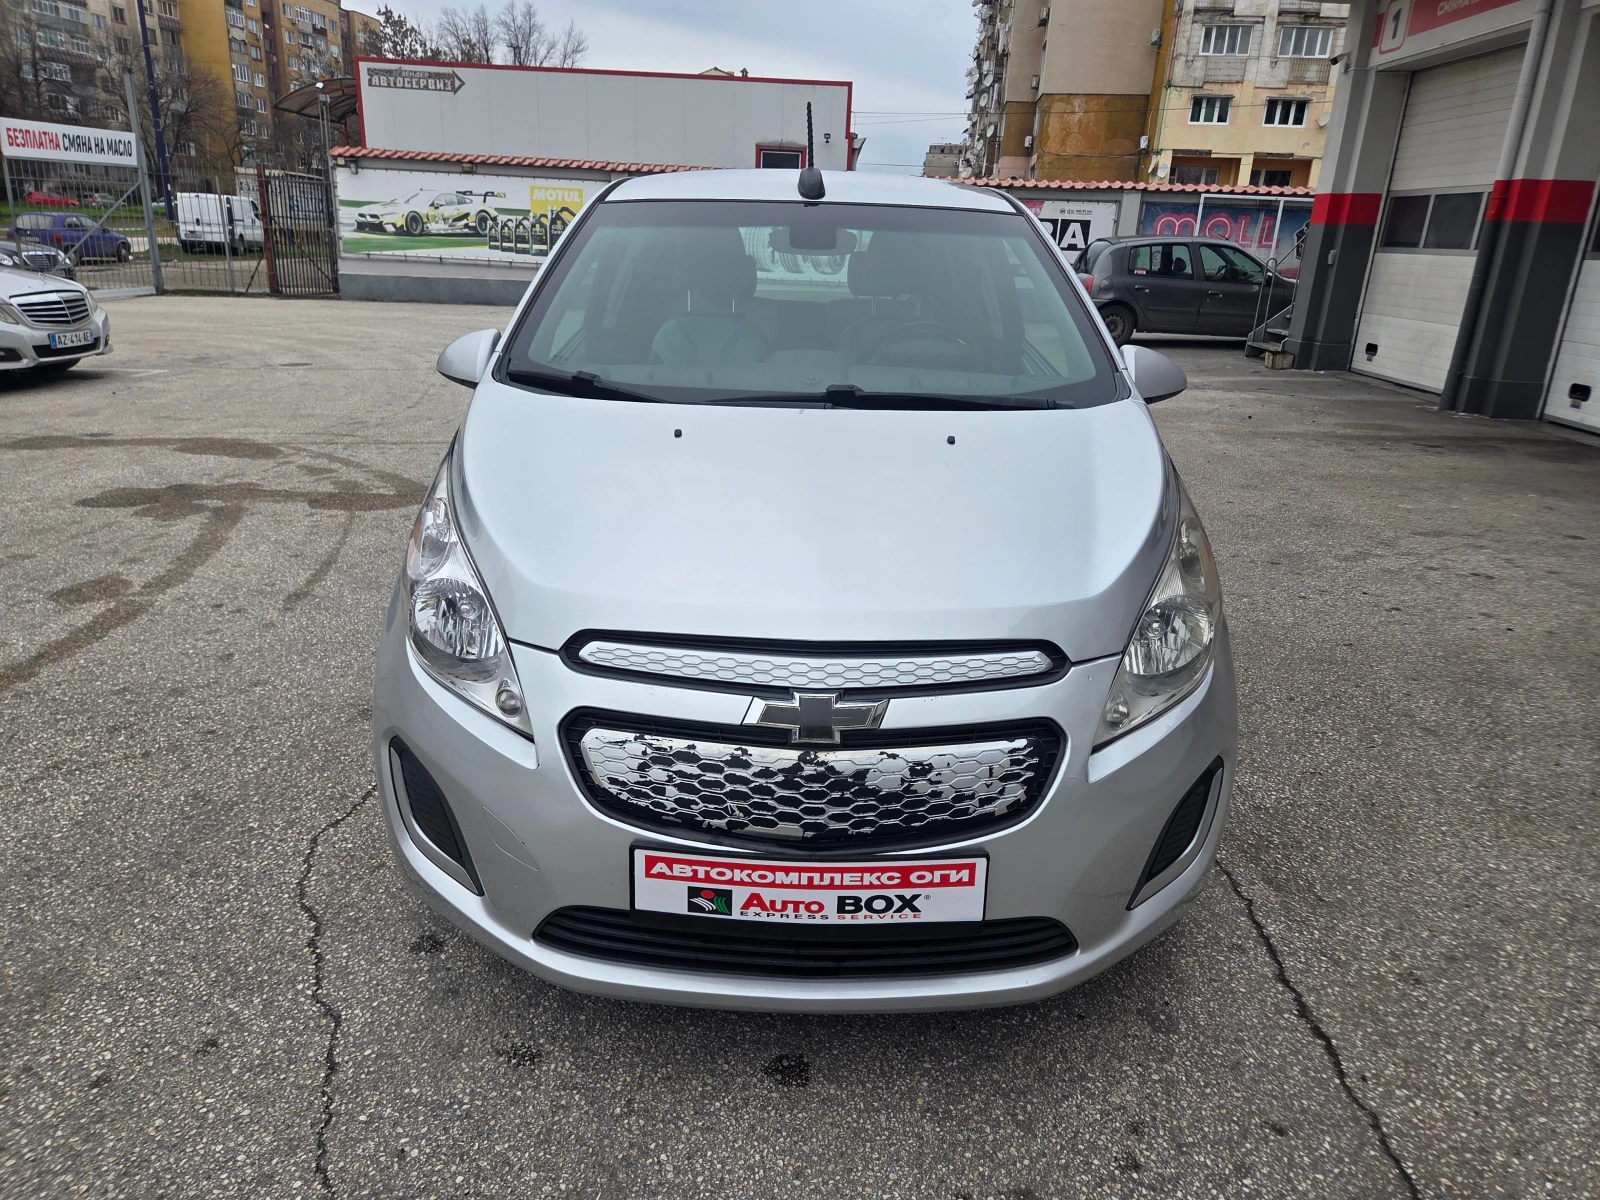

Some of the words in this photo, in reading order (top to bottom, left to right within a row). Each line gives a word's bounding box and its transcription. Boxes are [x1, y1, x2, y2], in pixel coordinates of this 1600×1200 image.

[1391, 7, 1402, 40] 1
[371, 76, 452, 91] АВТОСЕРВИЗ
[5, 127, 61, 151] БЕЗПЛАТНА
[61, 132, 93, 154] СМЯНА
[94, 136, 106, 155] НА
[106, 137, 133, 158] МАСЛО
[533, 188, 581, 203] MOTUL
[650, 862, 901, 886] АВТОКОМПЛЕКС
[909, 869, 969, 884] ОГИ
[836, 894, 922, 914] BOX
[740, 911, 829, 920] EXPRESS
